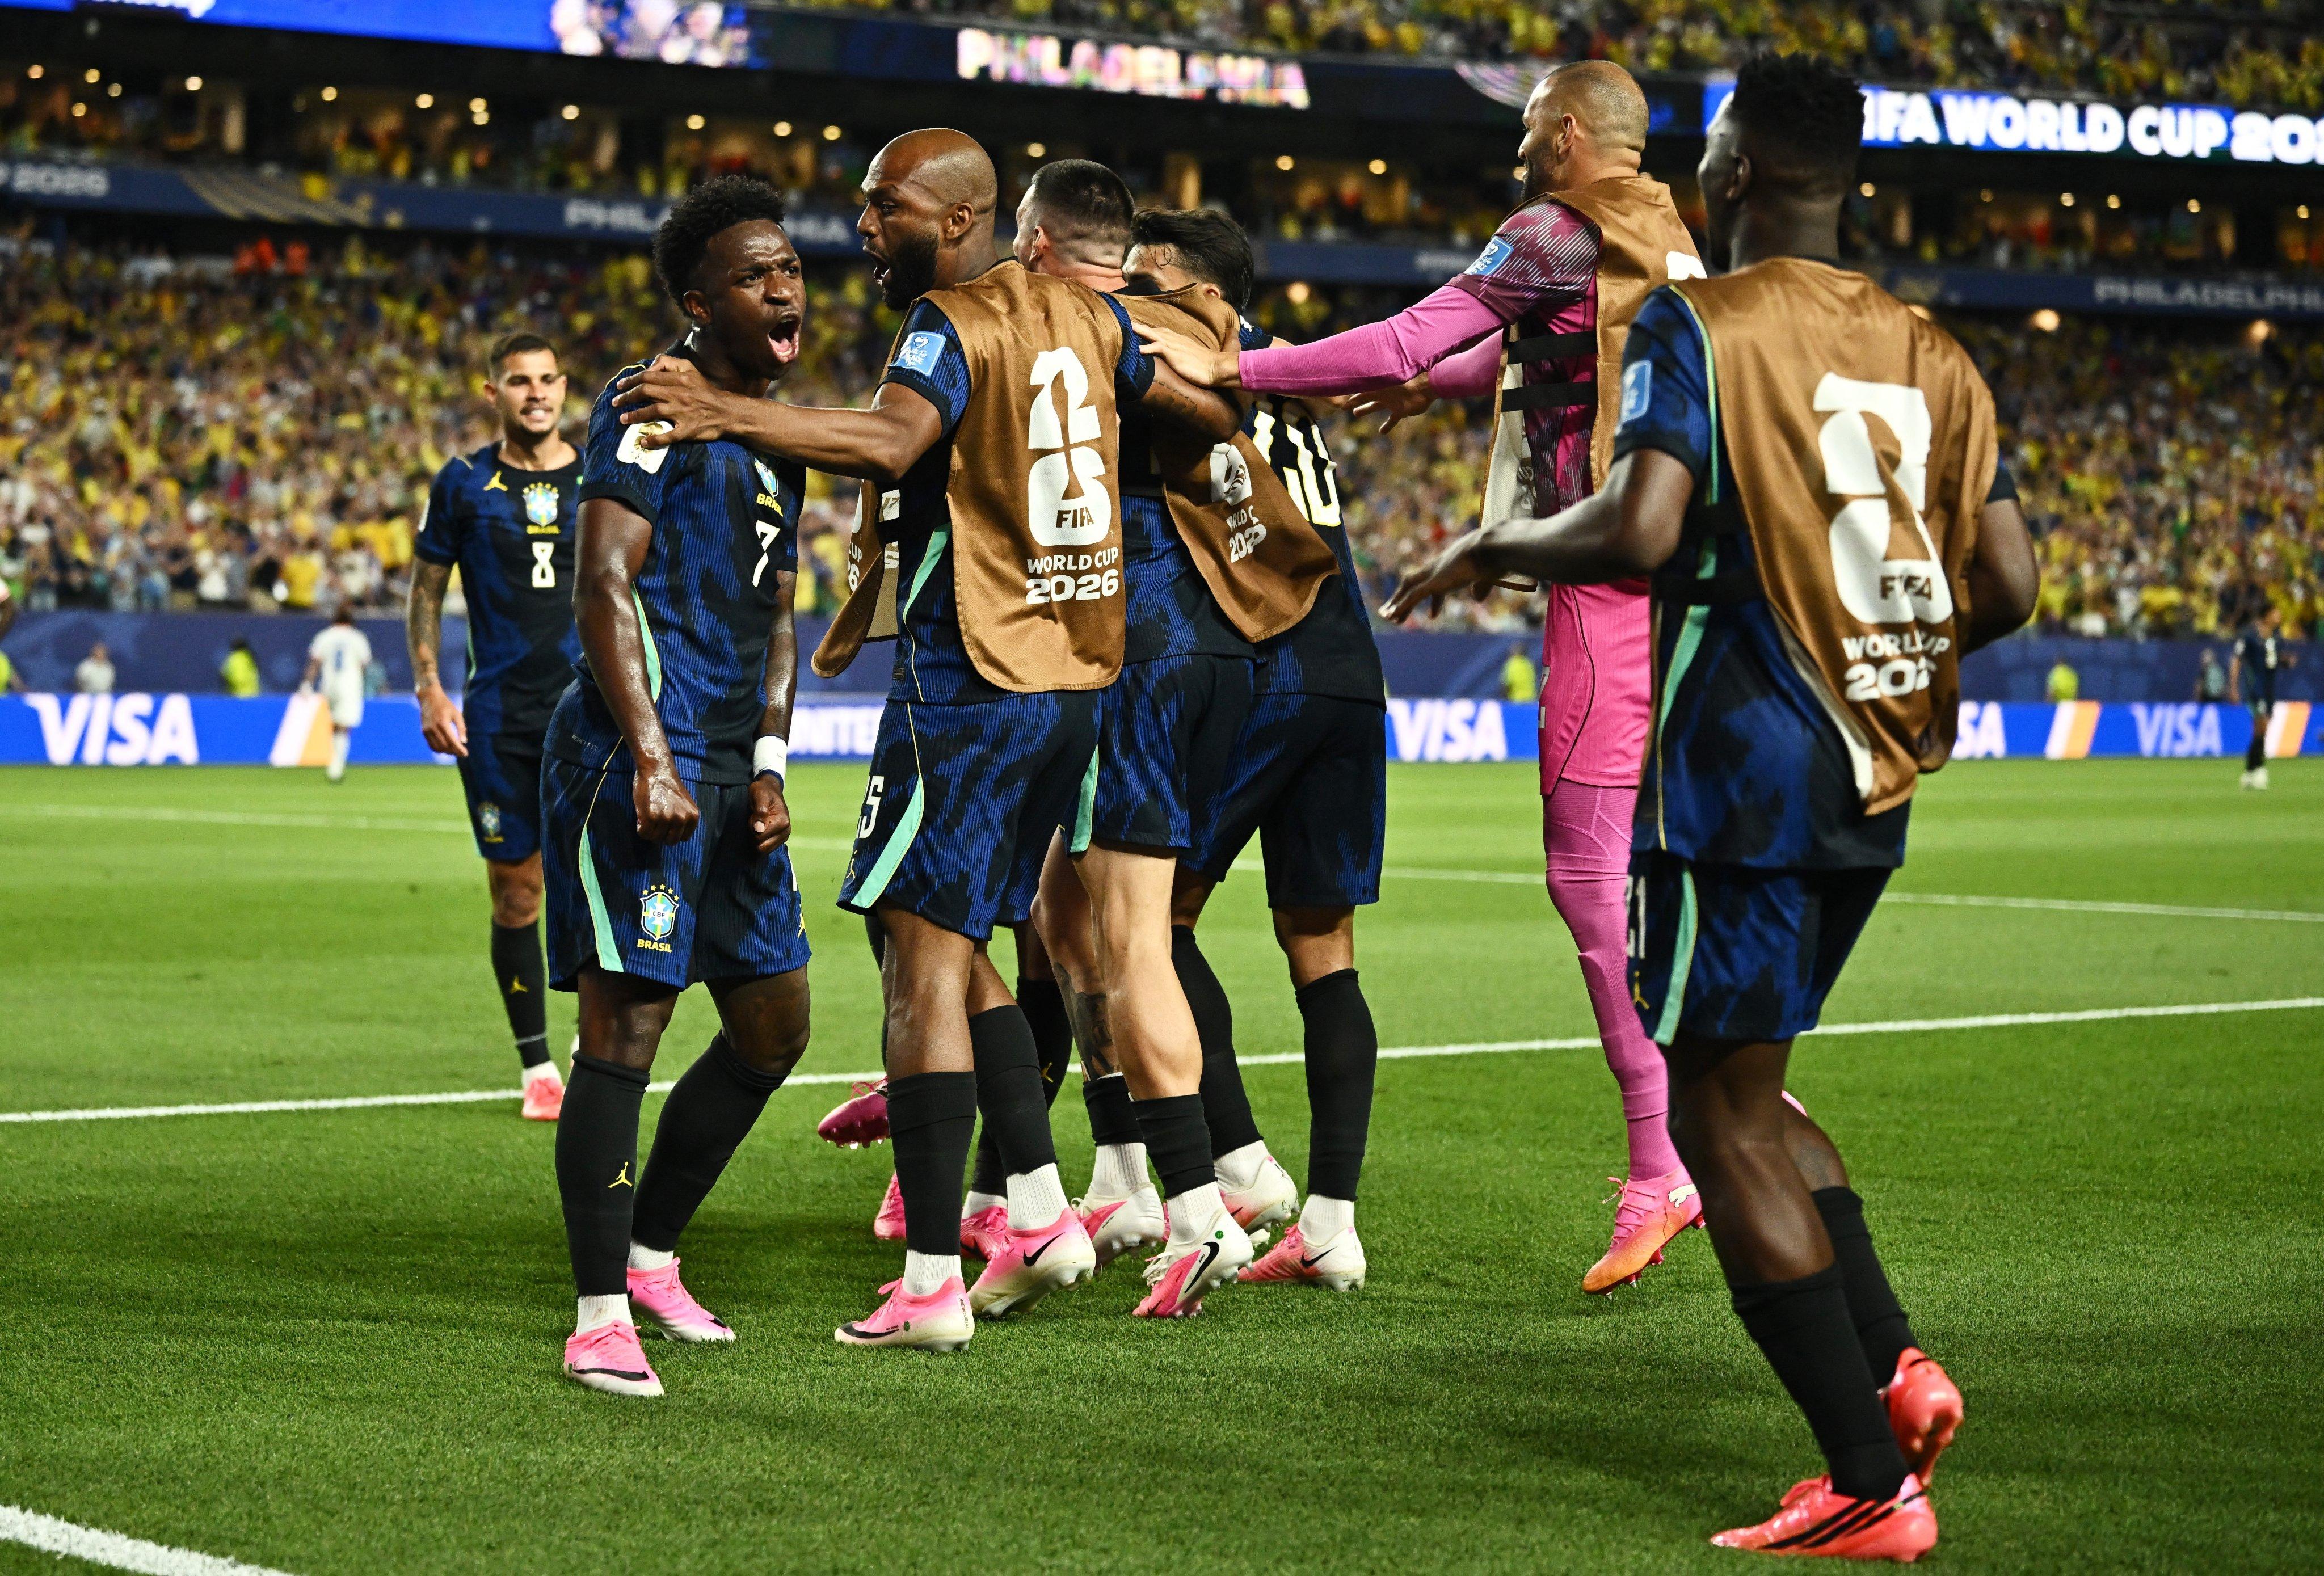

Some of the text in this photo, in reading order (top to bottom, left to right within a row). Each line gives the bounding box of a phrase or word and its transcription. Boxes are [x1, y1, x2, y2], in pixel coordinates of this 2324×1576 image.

[957, 28, 1309, 109] PHILADELPHIA
[1859, 89, 2324, 165] IFA WORLD CUP 20
[2094, 277, 2324, 311] PHILADELPHI
[1055, 509, 1094, 528] FIFA
[532, 541, 555, 588] 8
[752, 520, 781, 588] 7
[1027, 547, 1119, 574] WORLD CUP
[1025, 568, 1119, 605] 2026
[24, 692, 199, 765] VISA
[1386, 698, 1508, 762] VISA
[1951, 701, 2006, 760] SA
[2132, 702, 2222, 757] VISA
[856, 775, 885, 839] 5
[637, 939, 672, 953] BRASIL
